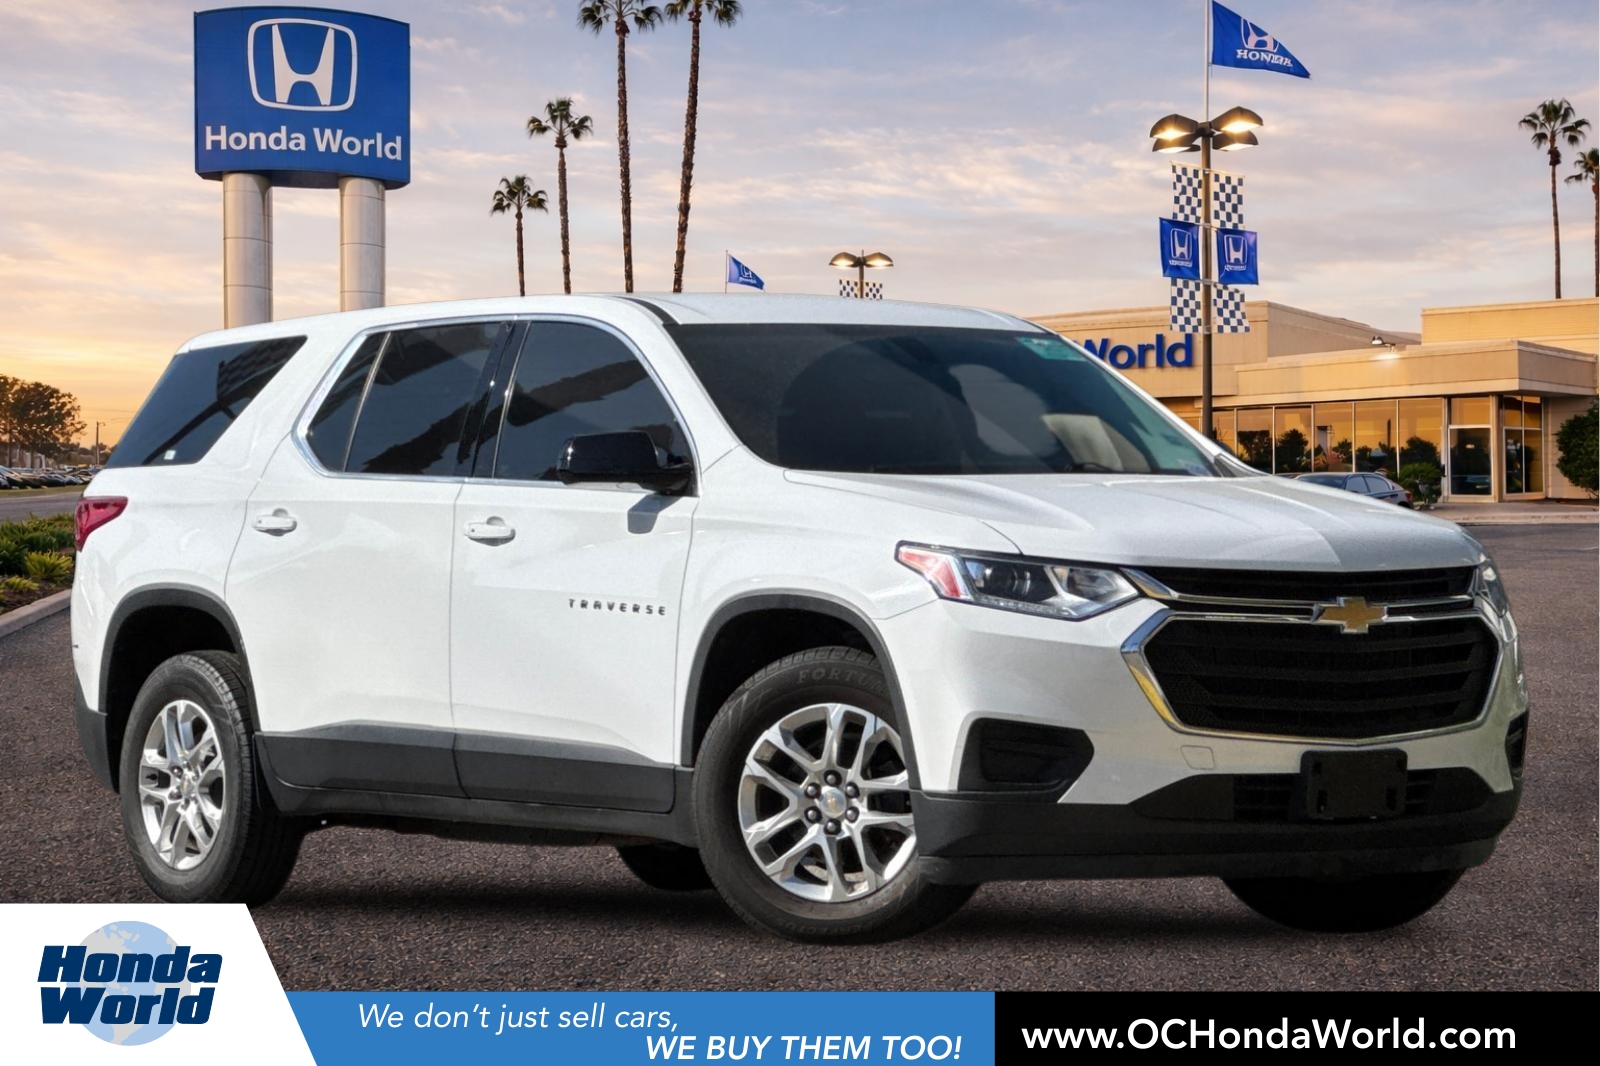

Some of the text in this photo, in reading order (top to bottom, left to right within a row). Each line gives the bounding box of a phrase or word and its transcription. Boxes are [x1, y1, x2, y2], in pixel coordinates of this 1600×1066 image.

[205, 125, 402, 161] Honda World
[568, 598, 667, 616] TRAVERSE
